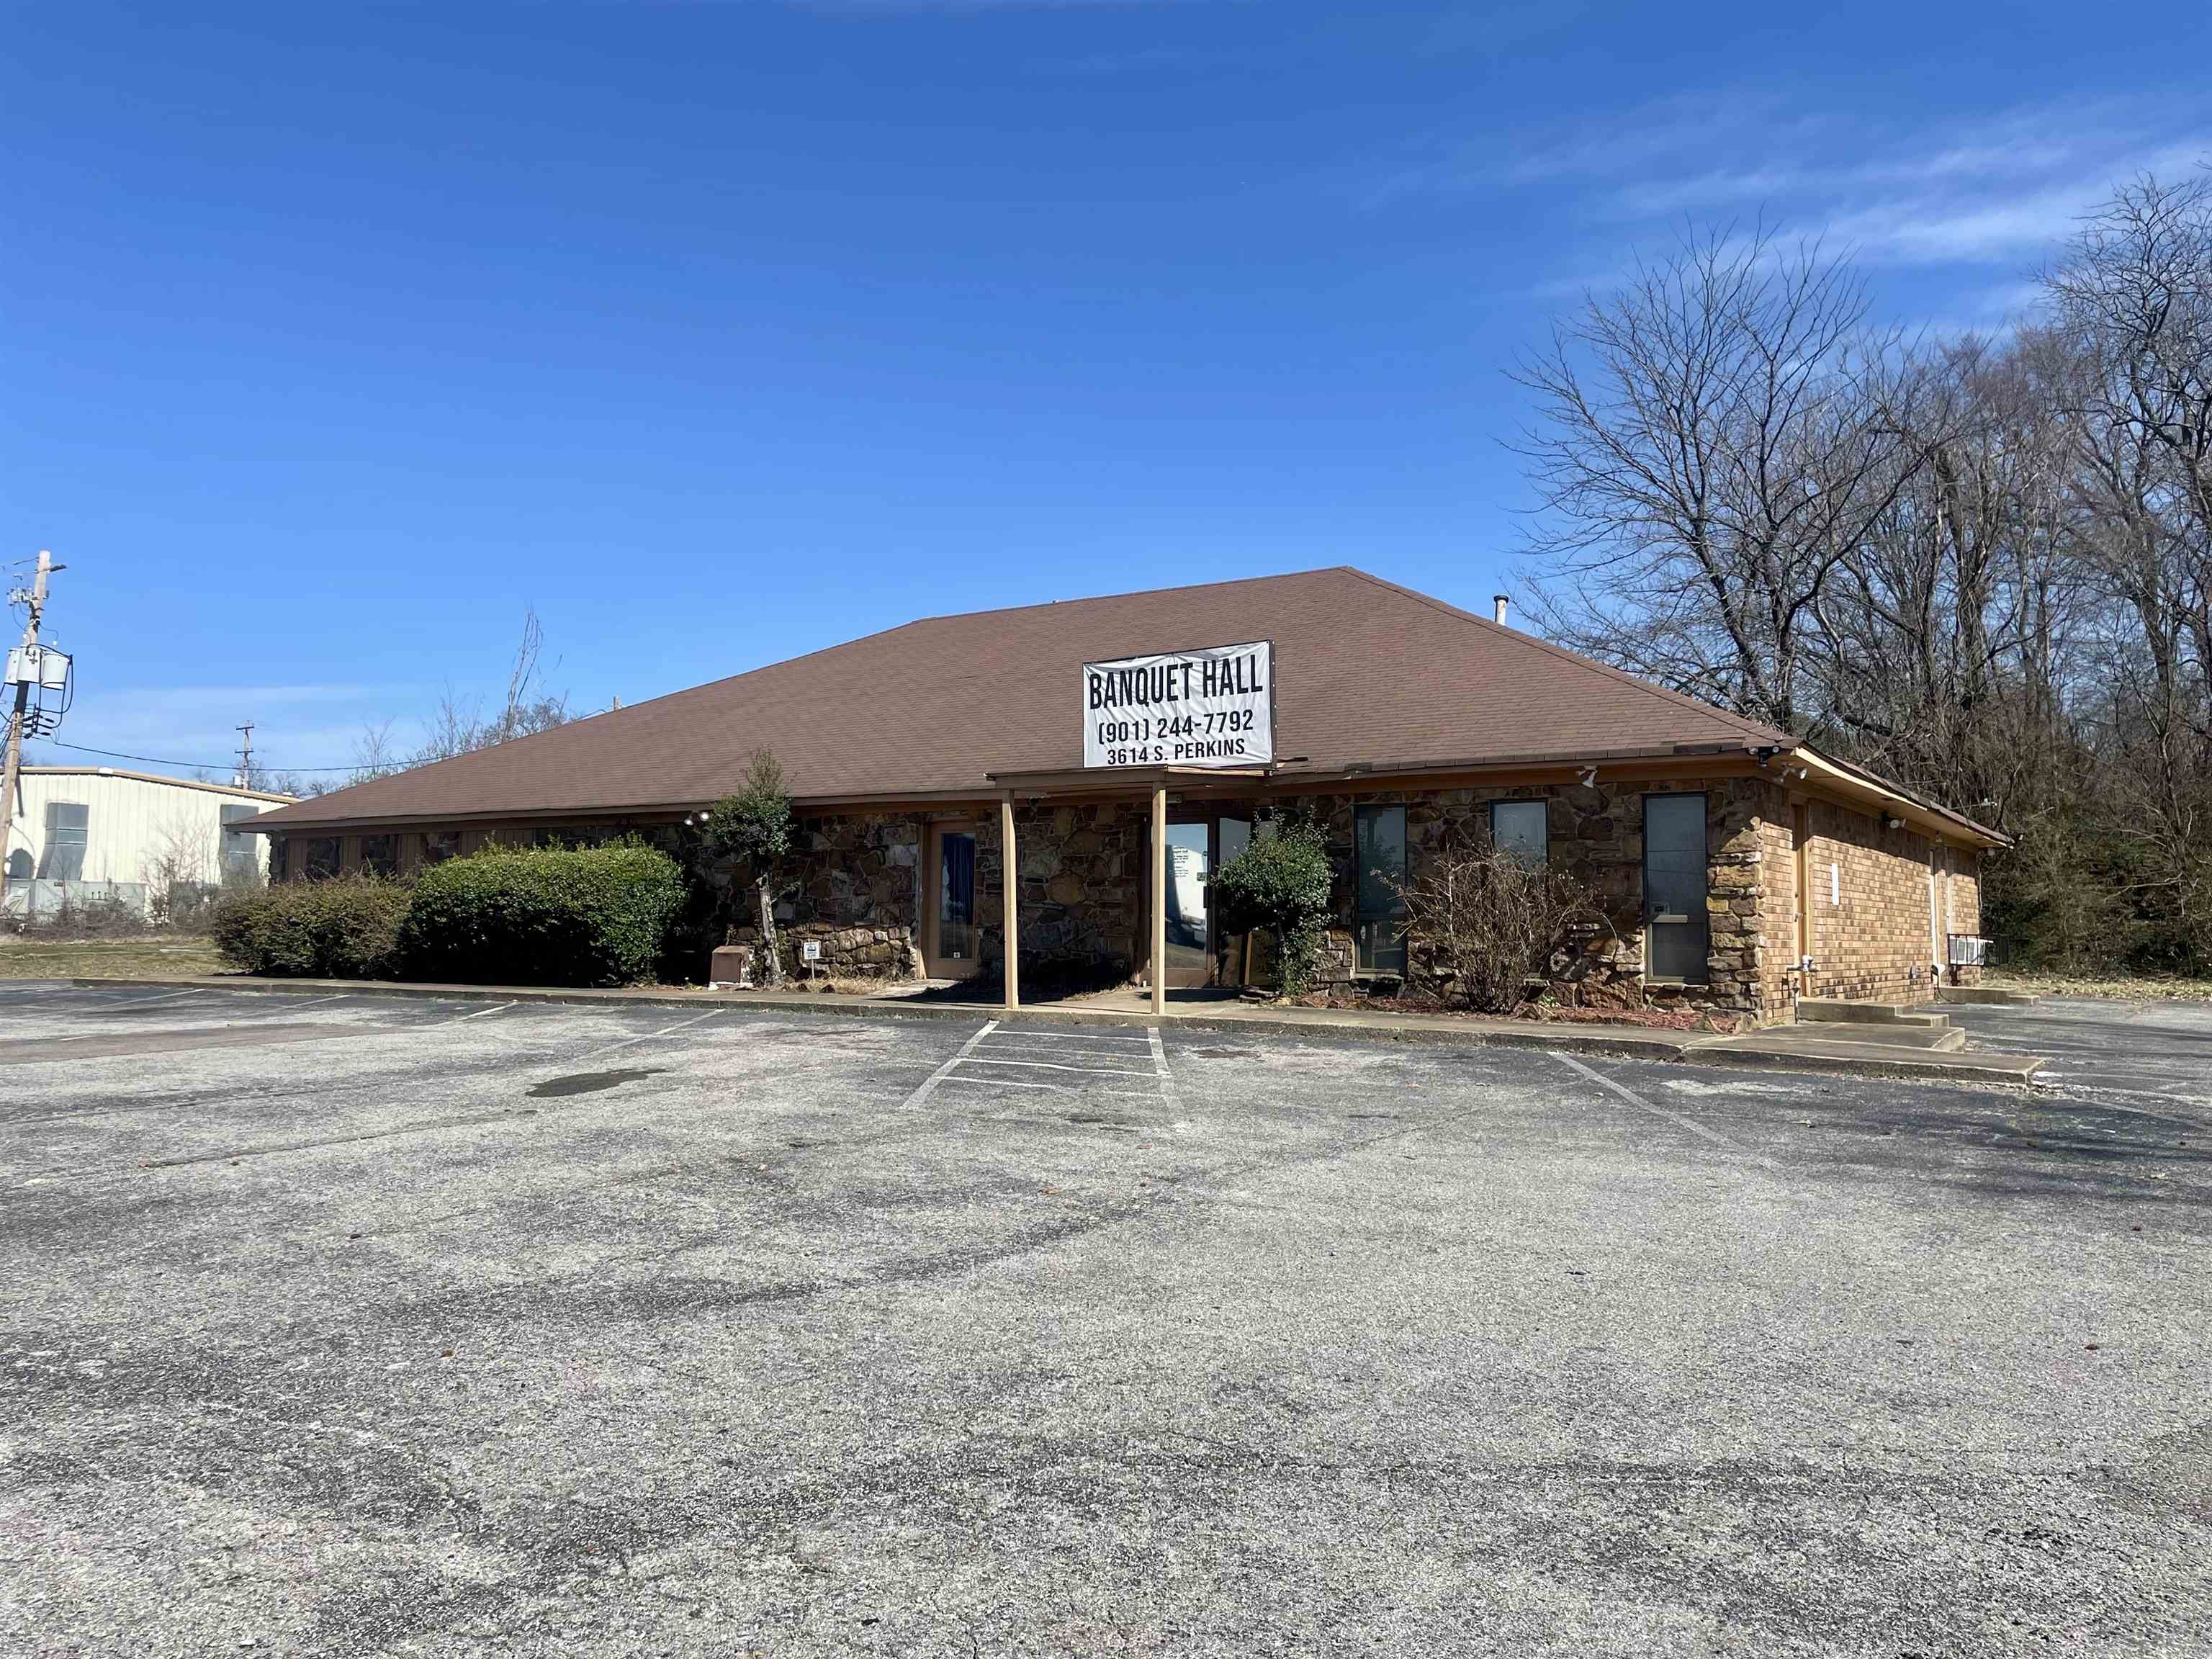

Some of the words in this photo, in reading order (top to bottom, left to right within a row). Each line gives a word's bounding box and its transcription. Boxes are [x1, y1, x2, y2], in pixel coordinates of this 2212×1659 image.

[1089, 662, 1193, 710] BANQUET
[1202, 654, 1263, 698] HALL
[1098, 719, 1150, 745] (901)
[1157, 709, 1254, 738] 244-7792
[1107, 747, 1148, 765] 3614
[1154, 745, 1168, 761] S.
[1174, 738, 1245, 760] PERKINS
